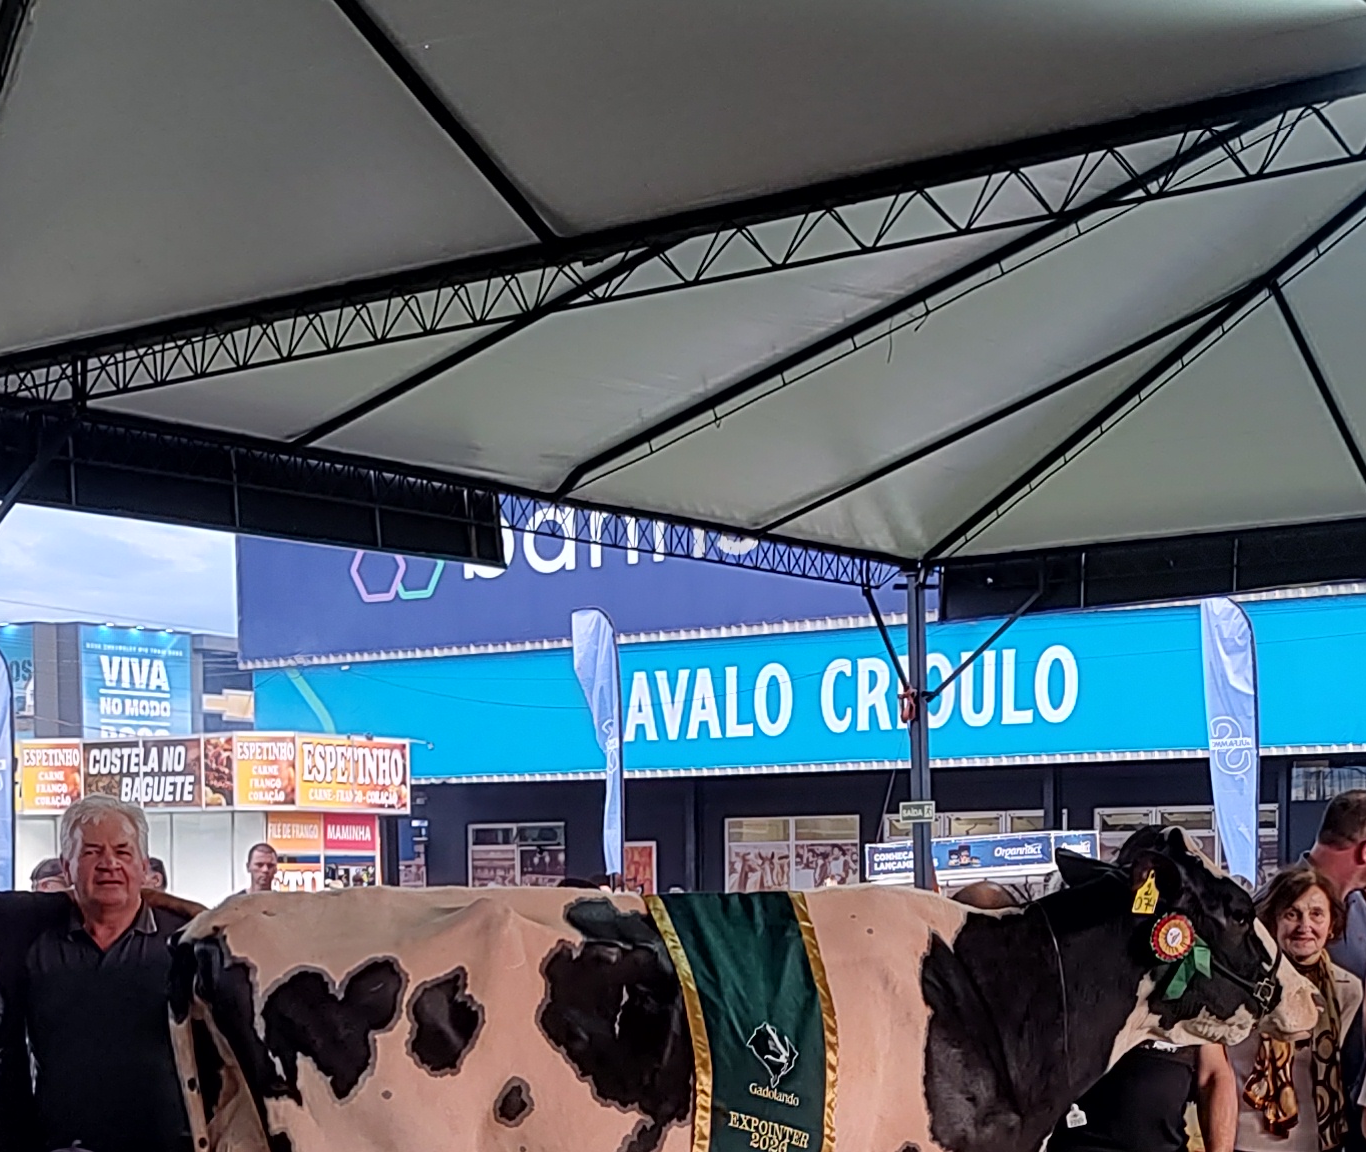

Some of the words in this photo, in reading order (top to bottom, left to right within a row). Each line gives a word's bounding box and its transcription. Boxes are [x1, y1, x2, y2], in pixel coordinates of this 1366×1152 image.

[99, 654, 171, 691] VIVA
[99, 696, 123, 715] NO
[124, 698, 171, 717] MODO
[624, 662, 793, 743] AVALO
[23, 748, 80, 767] ESPETINHO
[89, 747, 161, 775] COSTELA
[162, 745, 186, 772] NO
[237, 741, 295, 761] ESPETINHO
[251, 764, 279, 776] CARNE
[302, 742, 404, 786] ESPETINHO
[38, 770, 65, 781] CARNE
[249, 778, 282, 789] FRANGO
[36, 782, 68, 794] FRANGO
[121, 775, 195, 802] BAGUETE
[248, 789, 285, 803] CORAÇÃO
[35, 793, 72, 808] CORAÇÃO
[327, 823, 372, 841] MAMINHA
[749, 1082, 800, 1107] Gadolando
[728, 1111, 810, 1149] EXPOINTER
